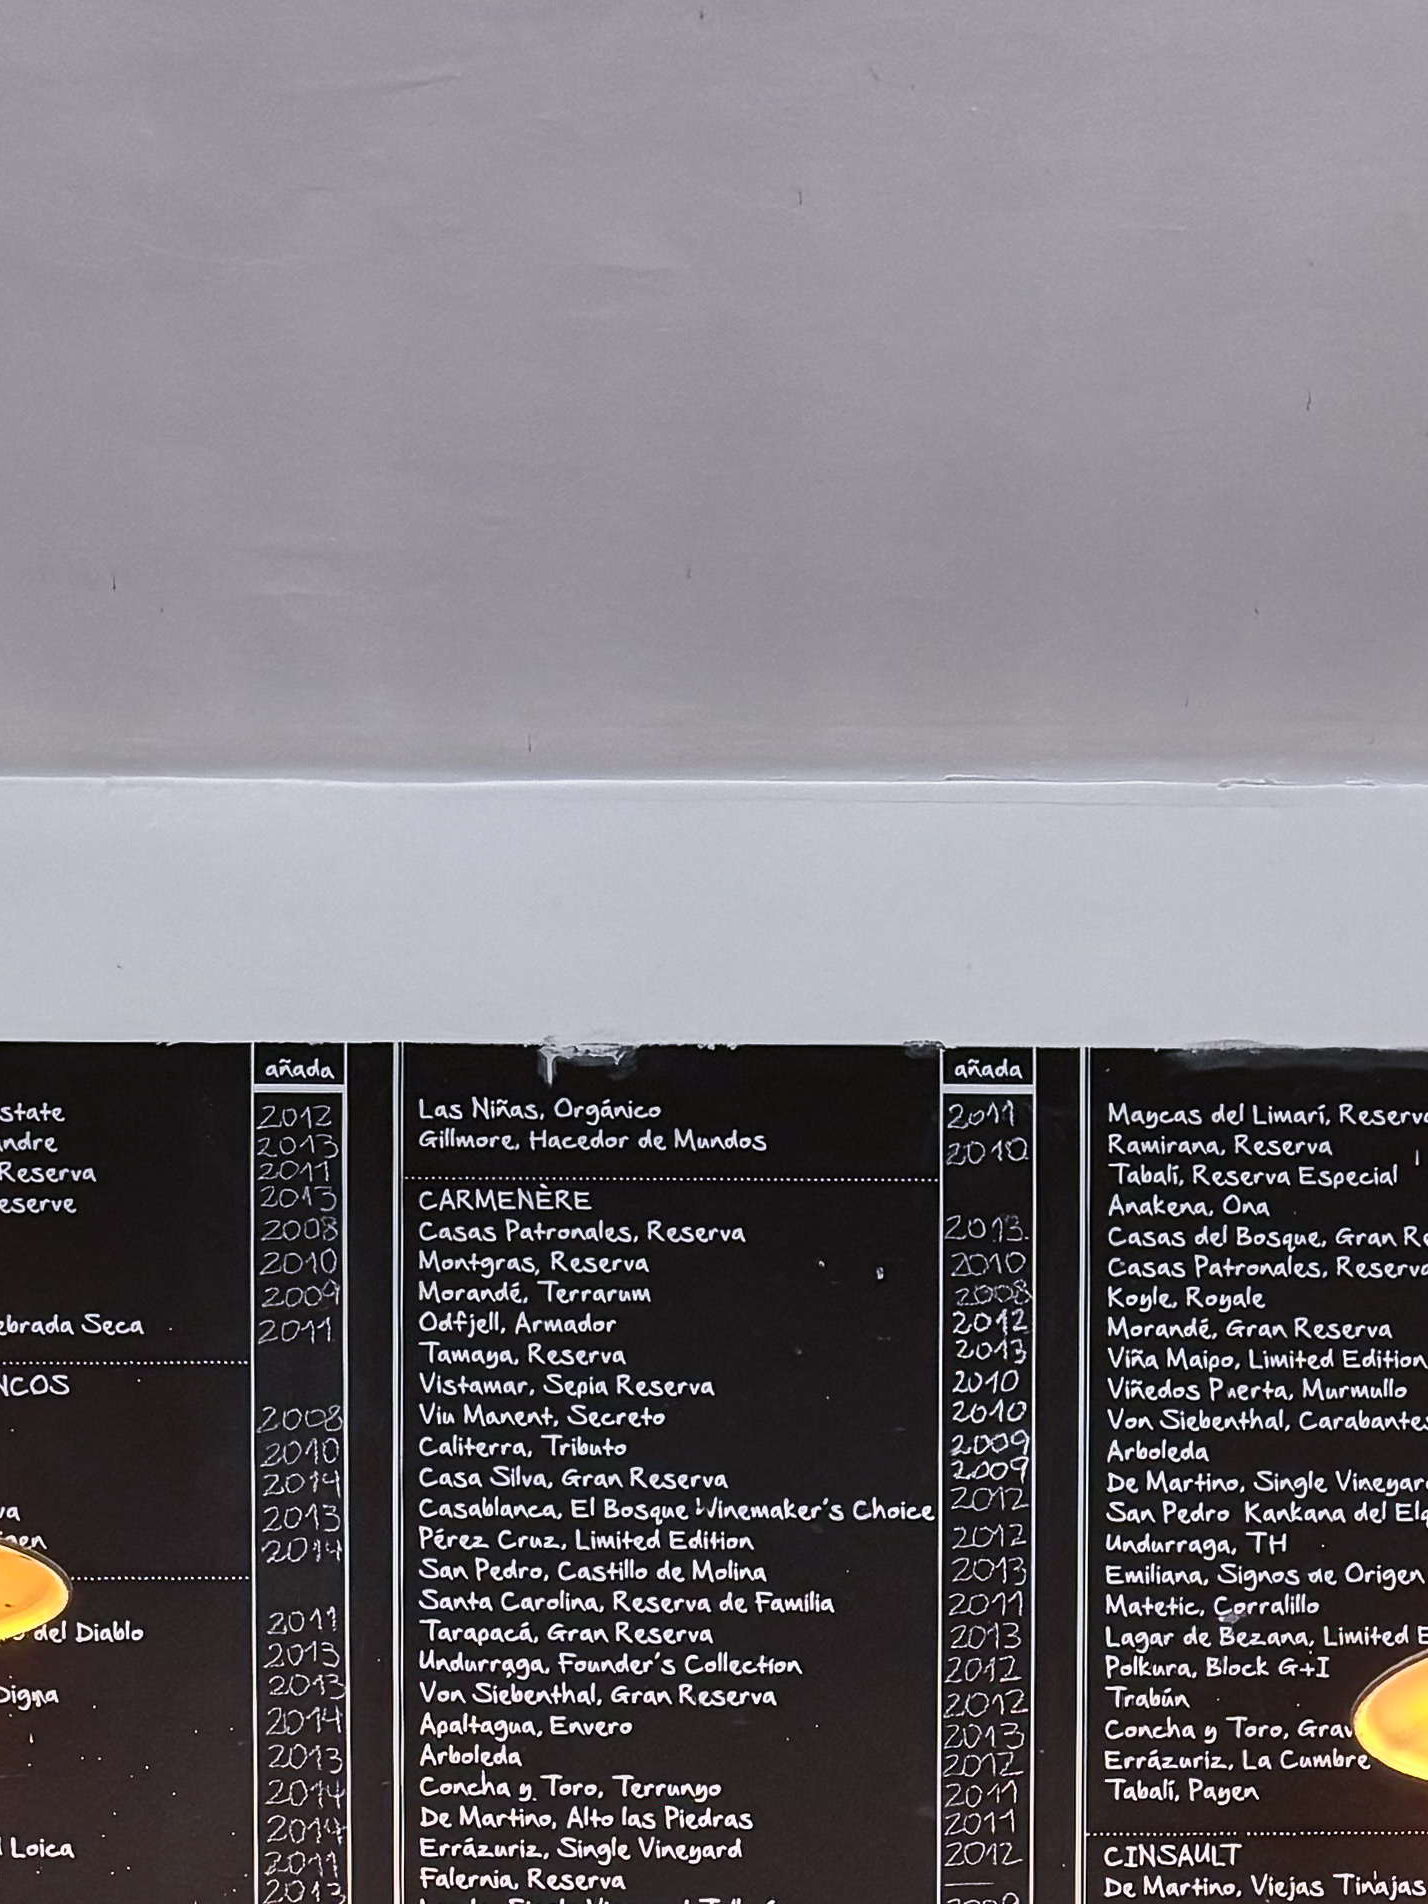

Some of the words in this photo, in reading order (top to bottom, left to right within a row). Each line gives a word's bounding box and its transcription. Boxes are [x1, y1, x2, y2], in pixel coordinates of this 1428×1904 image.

[265, 1059, 333, 1080] añada
[954, 1058, 1023, 1081] añada
[257, 1104, 331, 1129] 2012
[418, 1098, 463, 1120] Las
[471, 1095, 545, 1121] Niñas,
[553, 1097, 662, 1126] Orgánico
[947, 1098, 1015, 1128] 2011
[418, 1182, 593, 1212] CARMENÈRE
[262, 1251, 337, 1275] 2010
[1107, 1284, 1178, 1313] Koyle,
[1185, 1285, 1266, 1313] Royale
[418, 1310, 506, 1339] Odfjell,
[514, 1310, 617, 1335] Armador
[953, 1310, 1028, 1336] 2012
[952, 1370, 1018, 1395] 2010
[418, 1588, 494, 1612] Santa
[500, 1589, 605, 1614] Carolina,
[612, 1589, 712, 1614] Reserva
[718, 1591, 748, 1614] de
[754, 1590, 836, 1614] Familia
[1104, 1685, 1191, 1709] Trabún
[10, 1836, 76, 1859] Loica
[1103, 1842, 1243, 1868] CINSAULT
